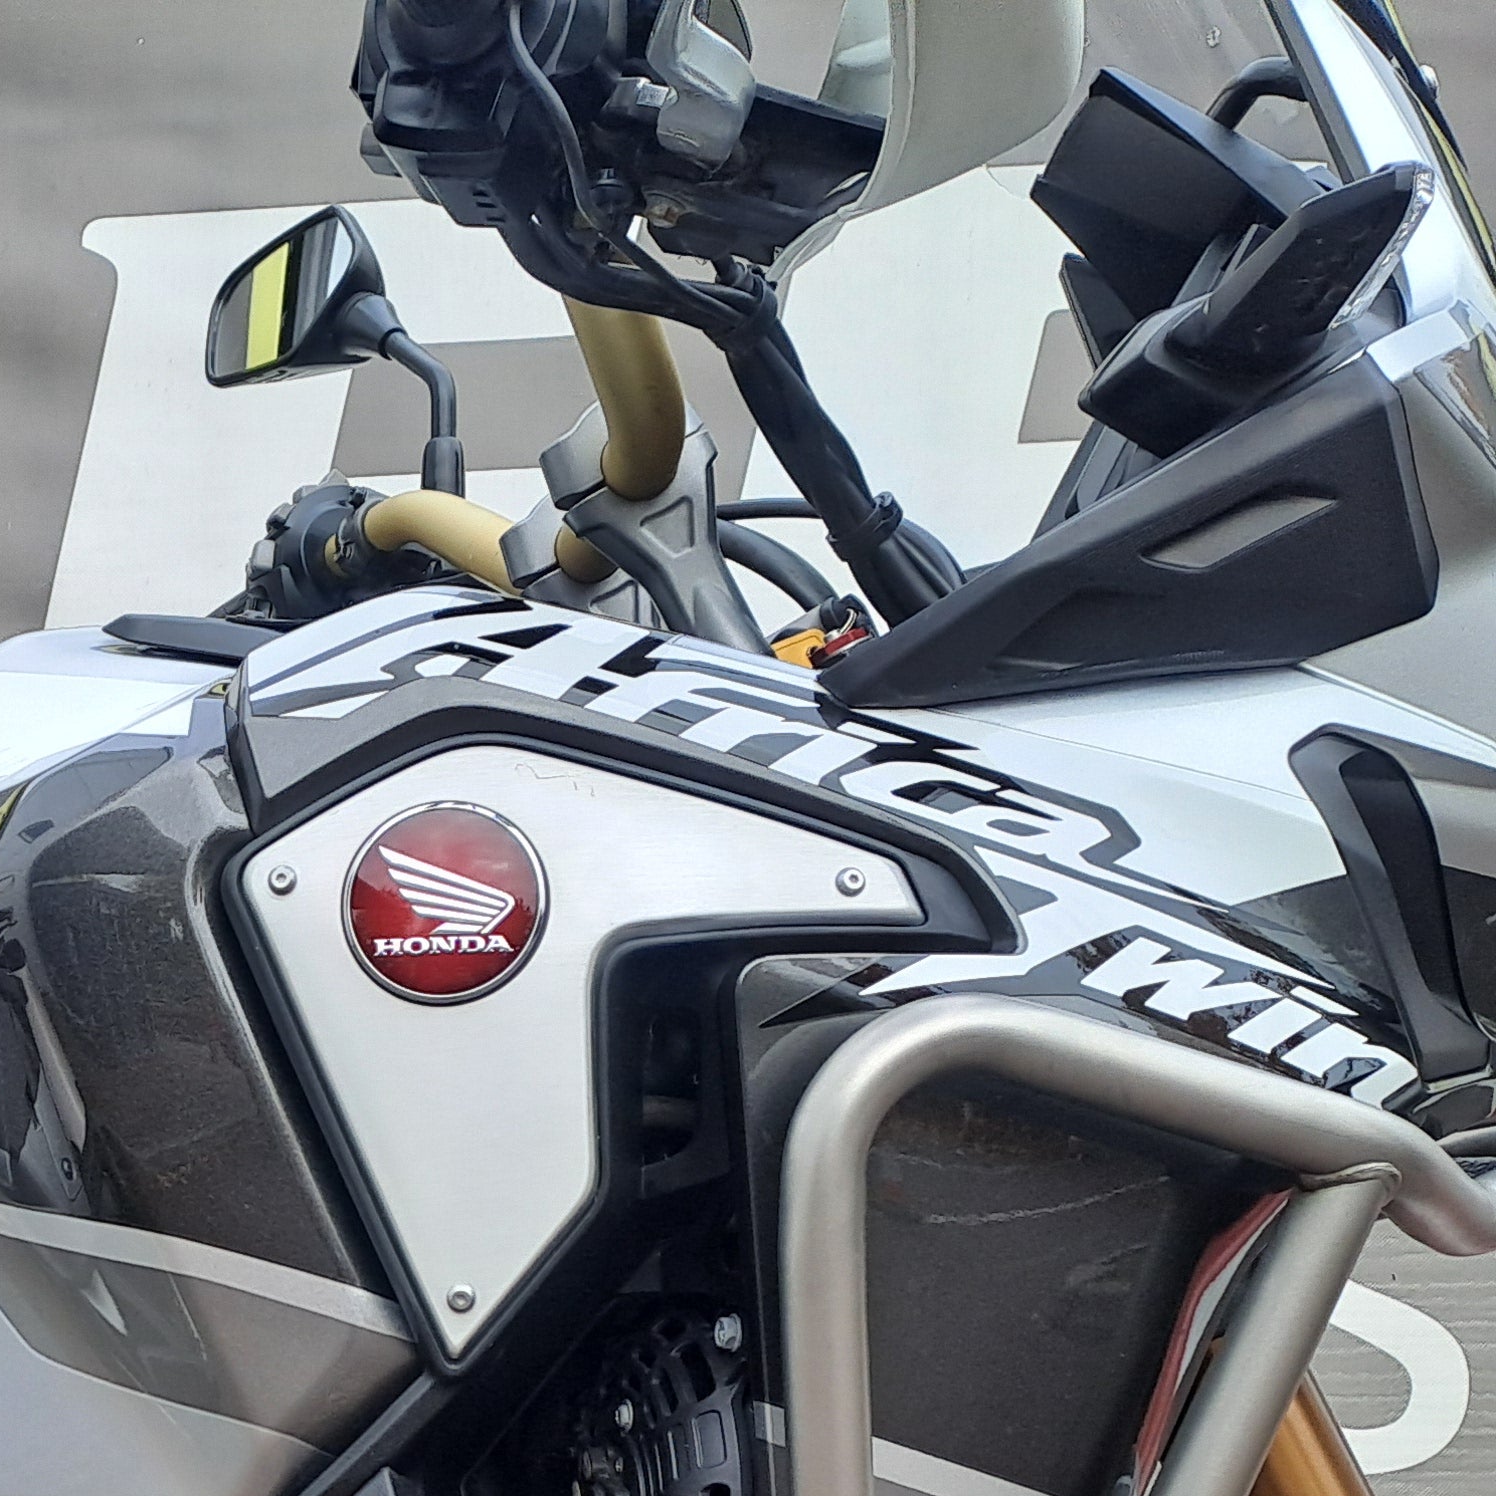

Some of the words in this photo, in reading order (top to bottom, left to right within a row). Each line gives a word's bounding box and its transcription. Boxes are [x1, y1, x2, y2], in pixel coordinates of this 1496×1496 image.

[254, 600, 1116, 868] Africa
[372, 934, 515, 957] HONDA
[858, 845, 1421, 1111] Twin
